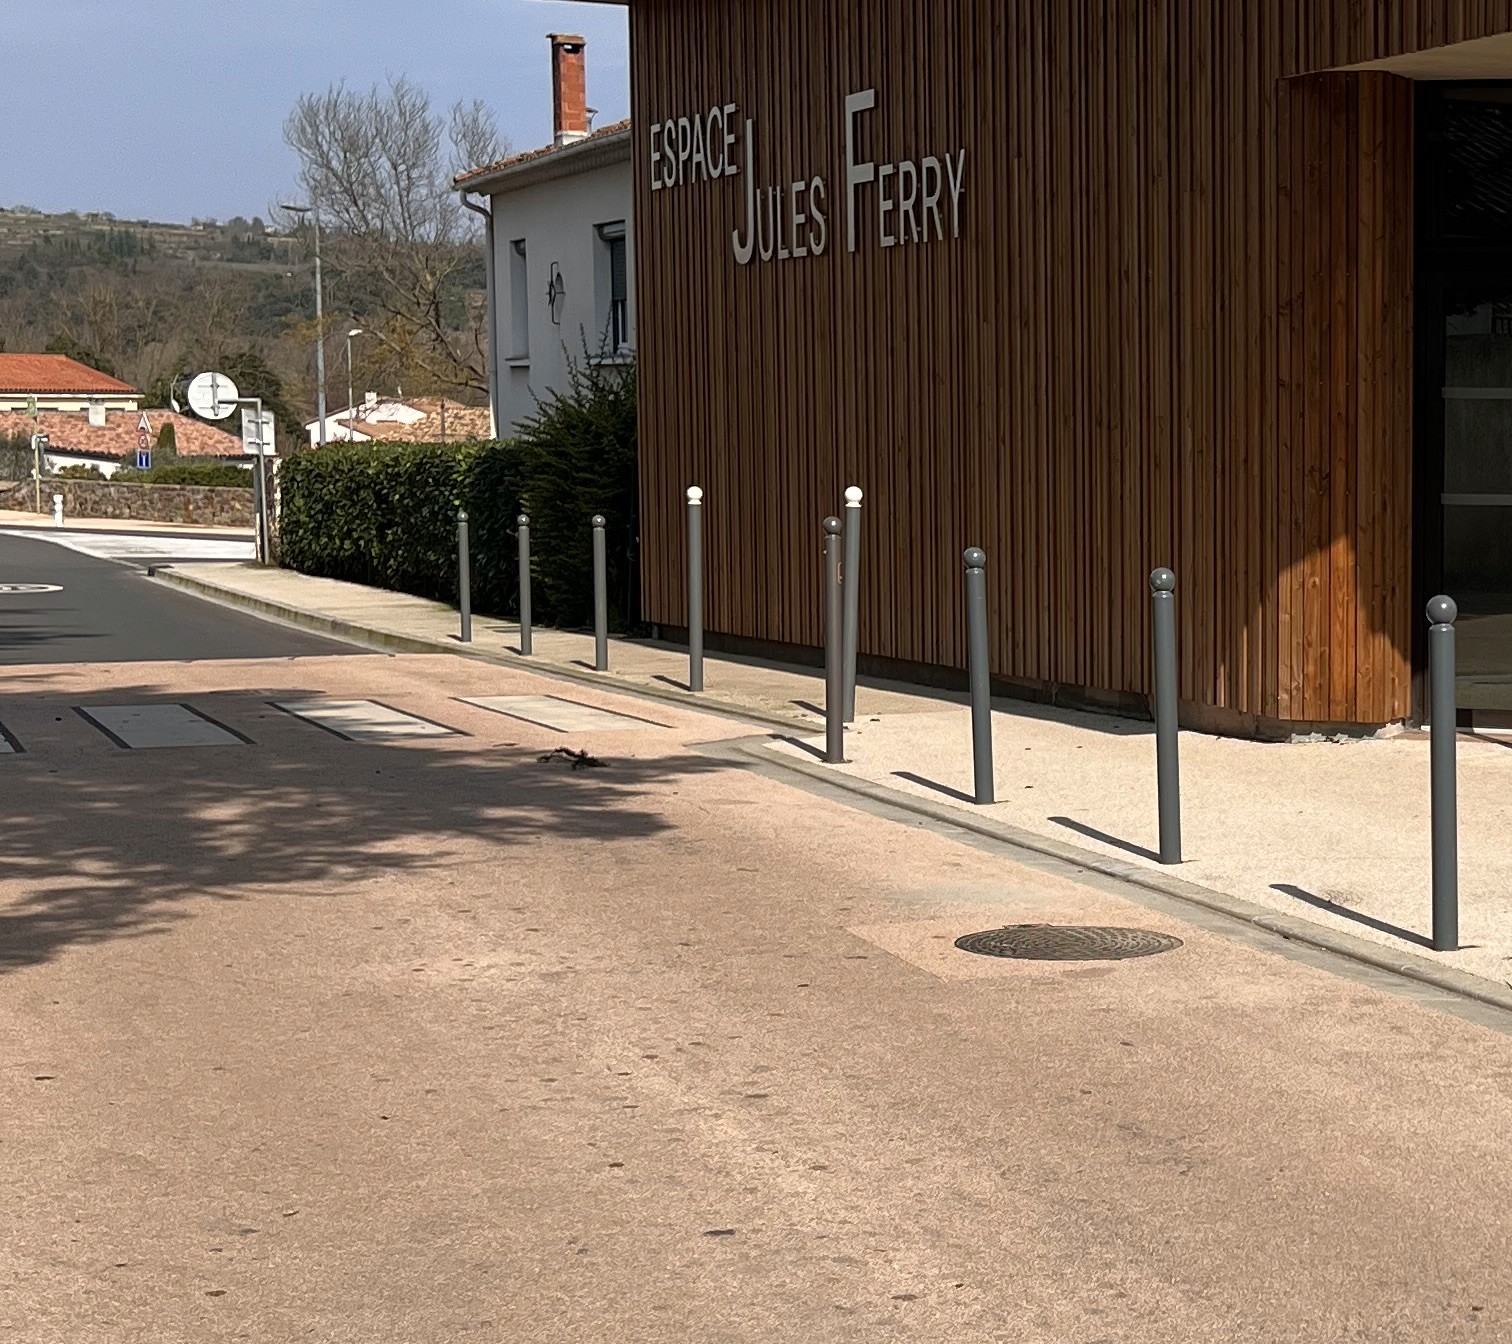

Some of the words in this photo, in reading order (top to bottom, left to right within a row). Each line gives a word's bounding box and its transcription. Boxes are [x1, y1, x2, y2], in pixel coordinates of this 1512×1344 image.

[650, 103, 737, 191] ESPACE
[732, 118, 826, 265] JULES
[845, 88, 965, 253] FERRY
